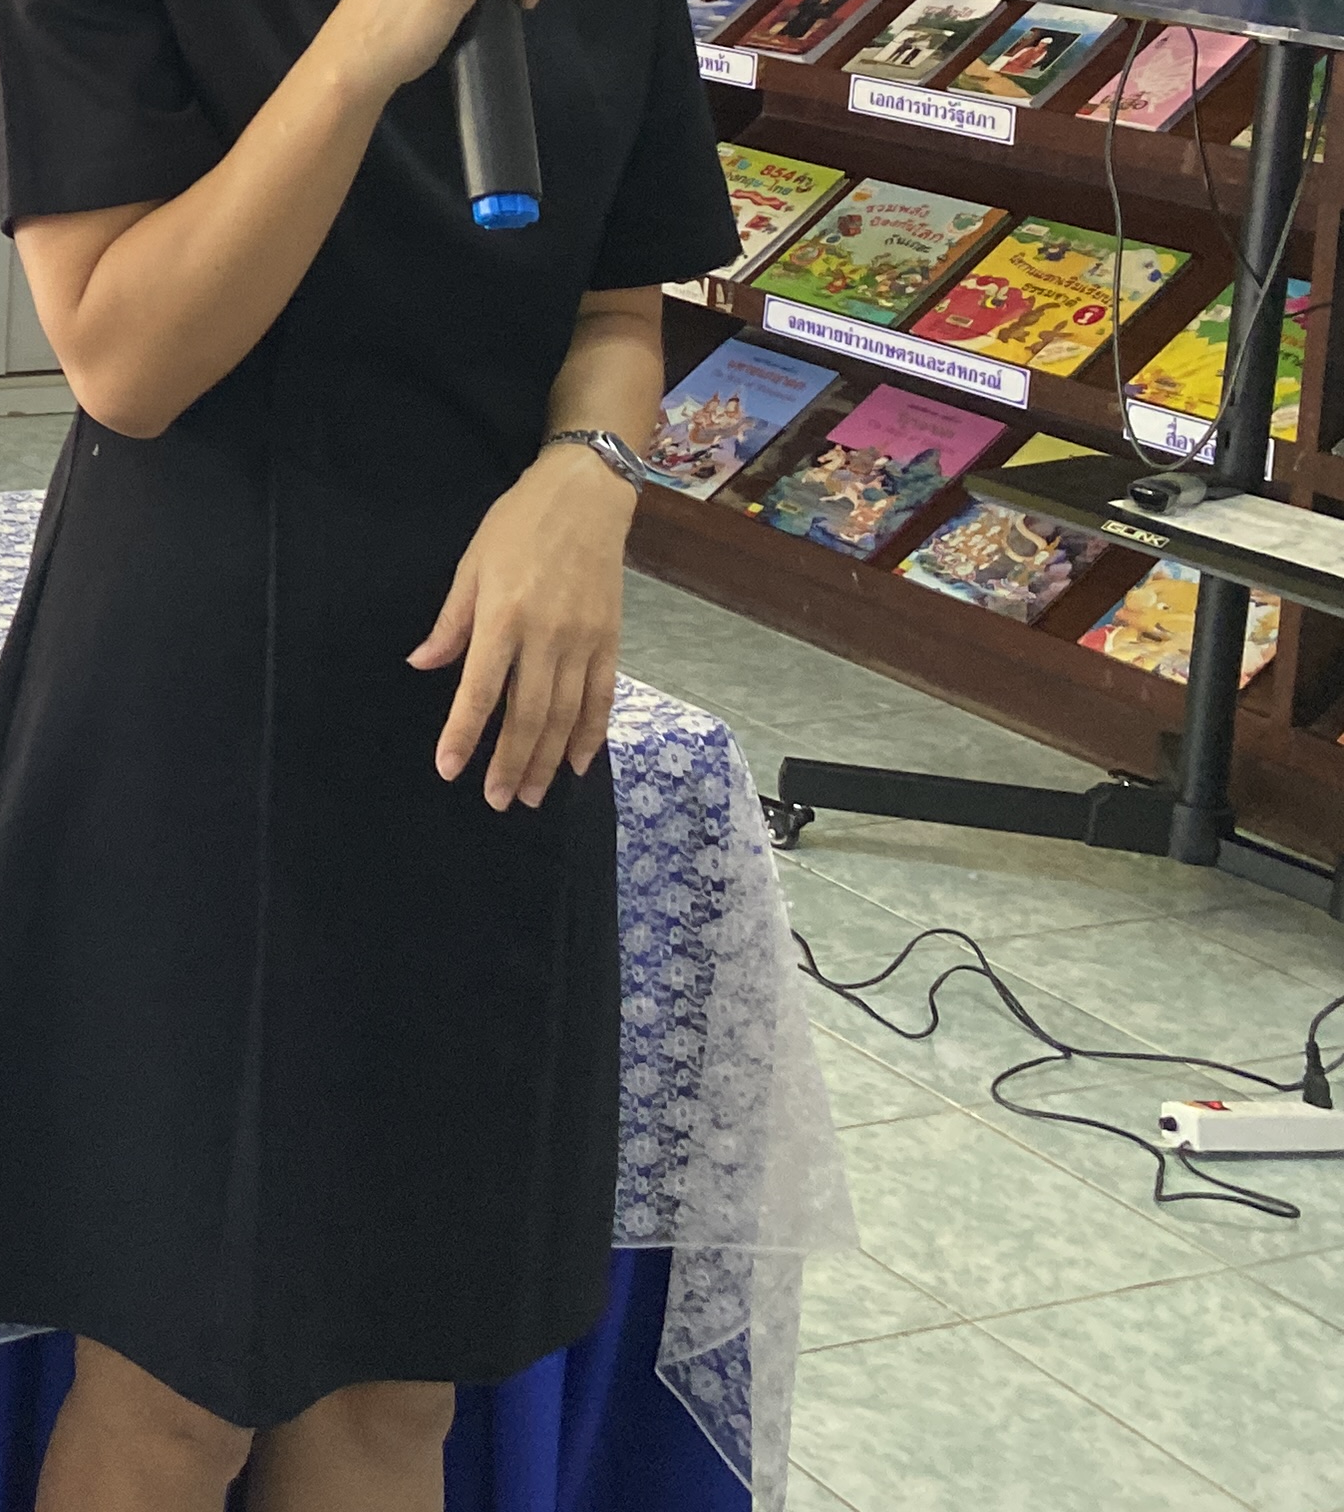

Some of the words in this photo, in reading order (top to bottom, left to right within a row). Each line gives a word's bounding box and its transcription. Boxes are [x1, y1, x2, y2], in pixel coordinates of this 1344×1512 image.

[869, 91, 996, 130] เอกสารข่าวรัฐสภา
[788, 314, 1002, 390] จดหมายข่าวเกษตรและสหกรณ์
